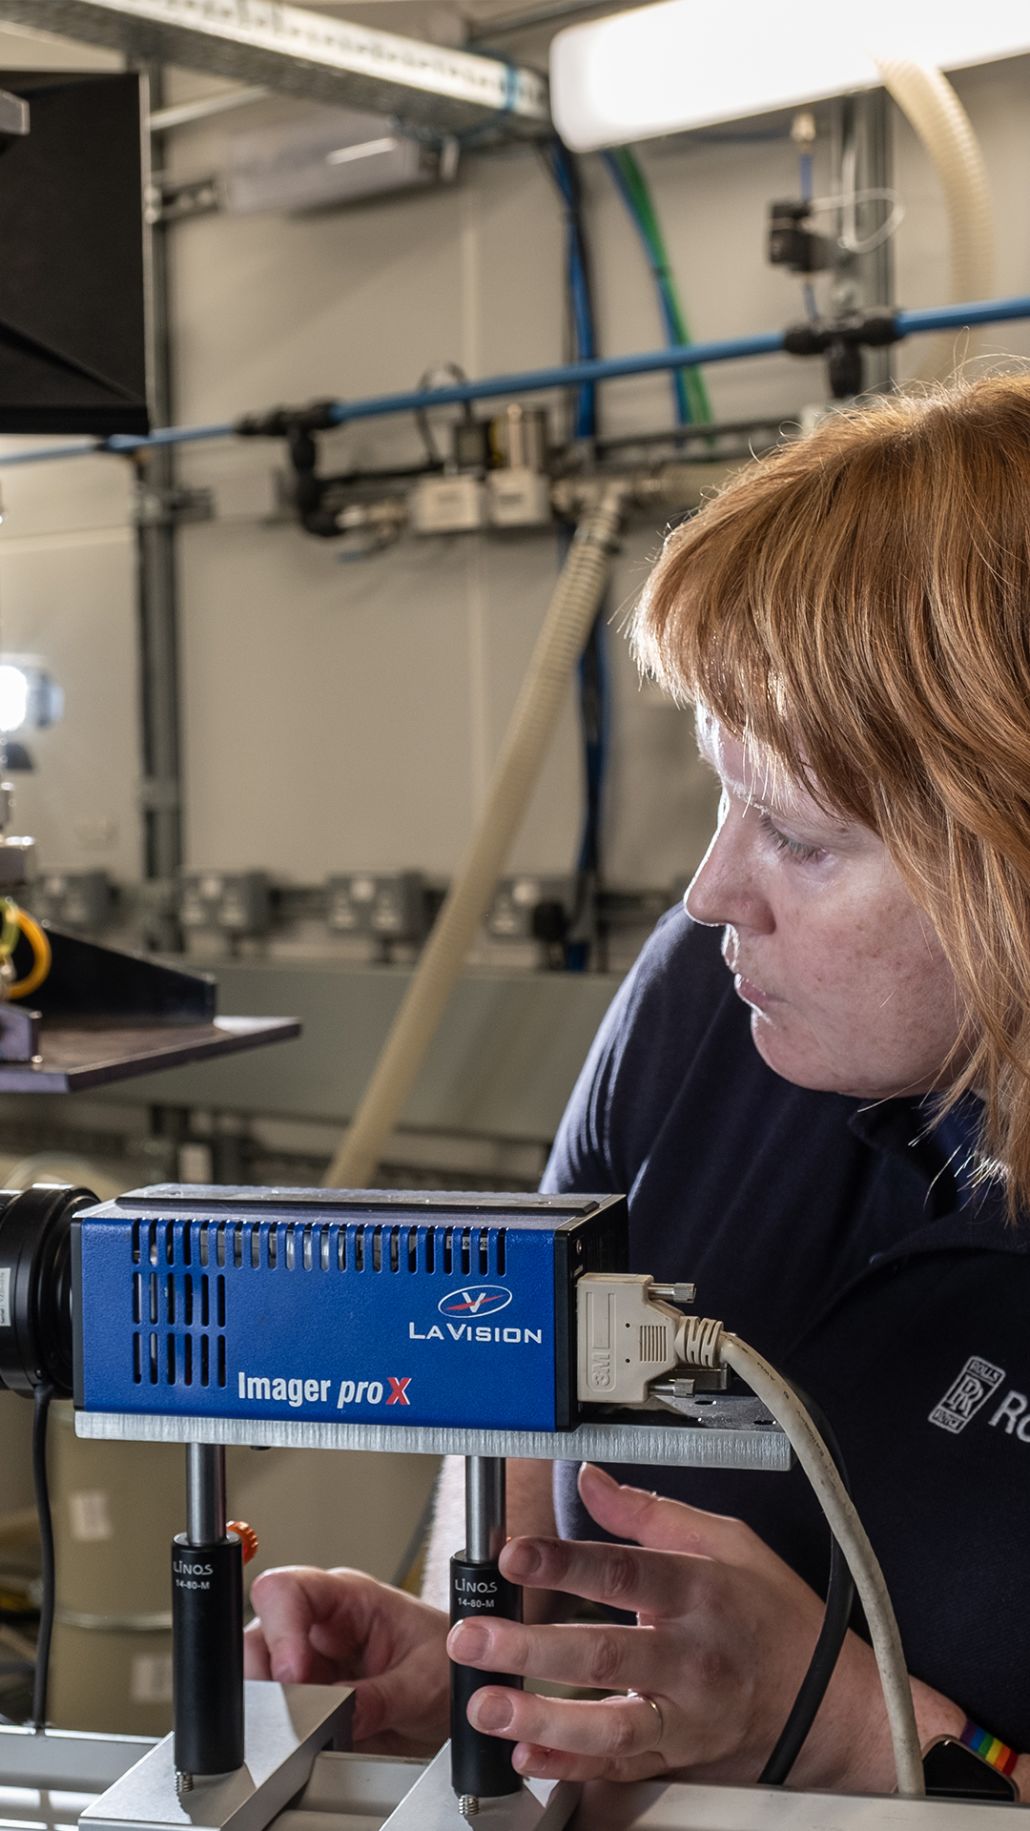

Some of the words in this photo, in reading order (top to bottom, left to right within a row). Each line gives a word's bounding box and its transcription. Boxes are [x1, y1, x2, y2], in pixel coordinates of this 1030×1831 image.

[238, 1371, 332, 1408] Imager
[175, 1579, 211, 1590] 14-80-M
[458, 1597, 495, 1608] 14-80-M
